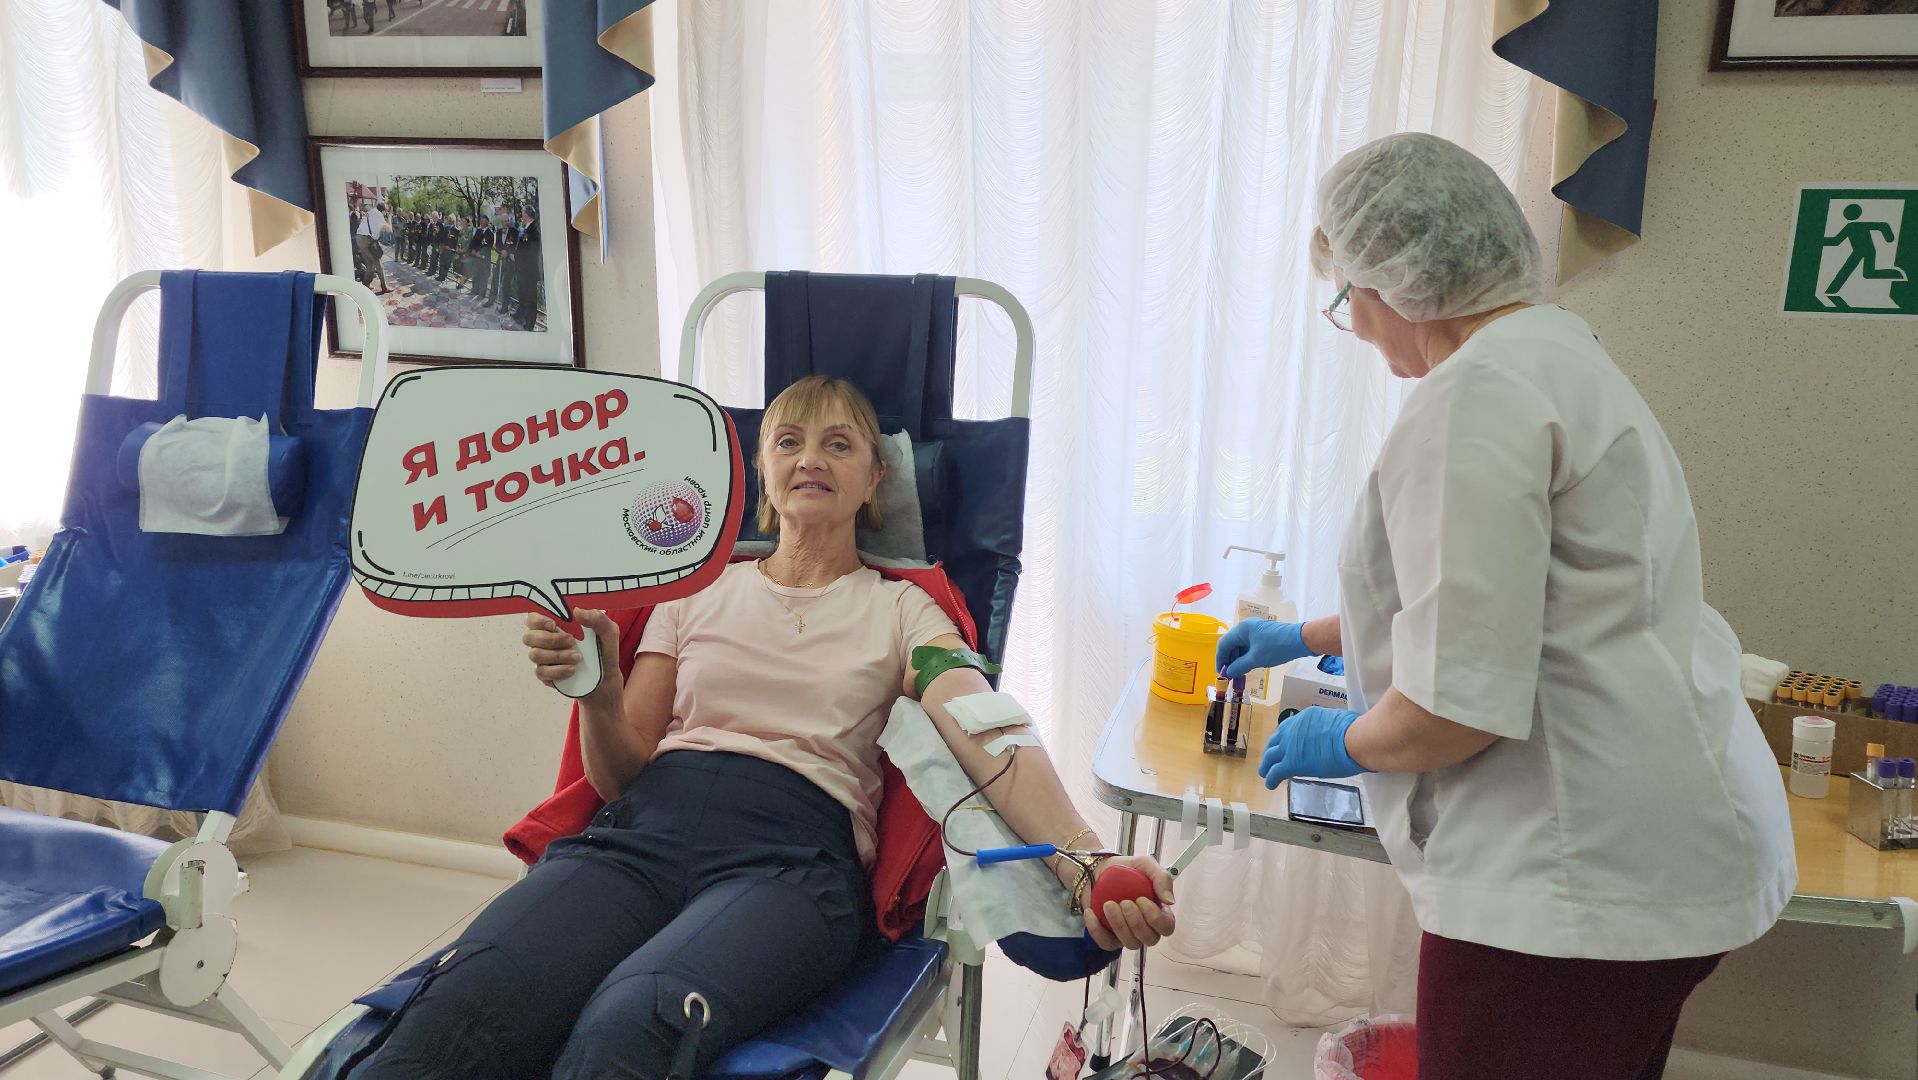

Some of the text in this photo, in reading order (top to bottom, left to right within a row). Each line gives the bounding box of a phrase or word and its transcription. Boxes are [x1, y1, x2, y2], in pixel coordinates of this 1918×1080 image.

[402, 389, 629, 486] Я донор
[412, 437, 646, 532] и точка.
[622, 476, 712, 556] Московский областной центр крови
